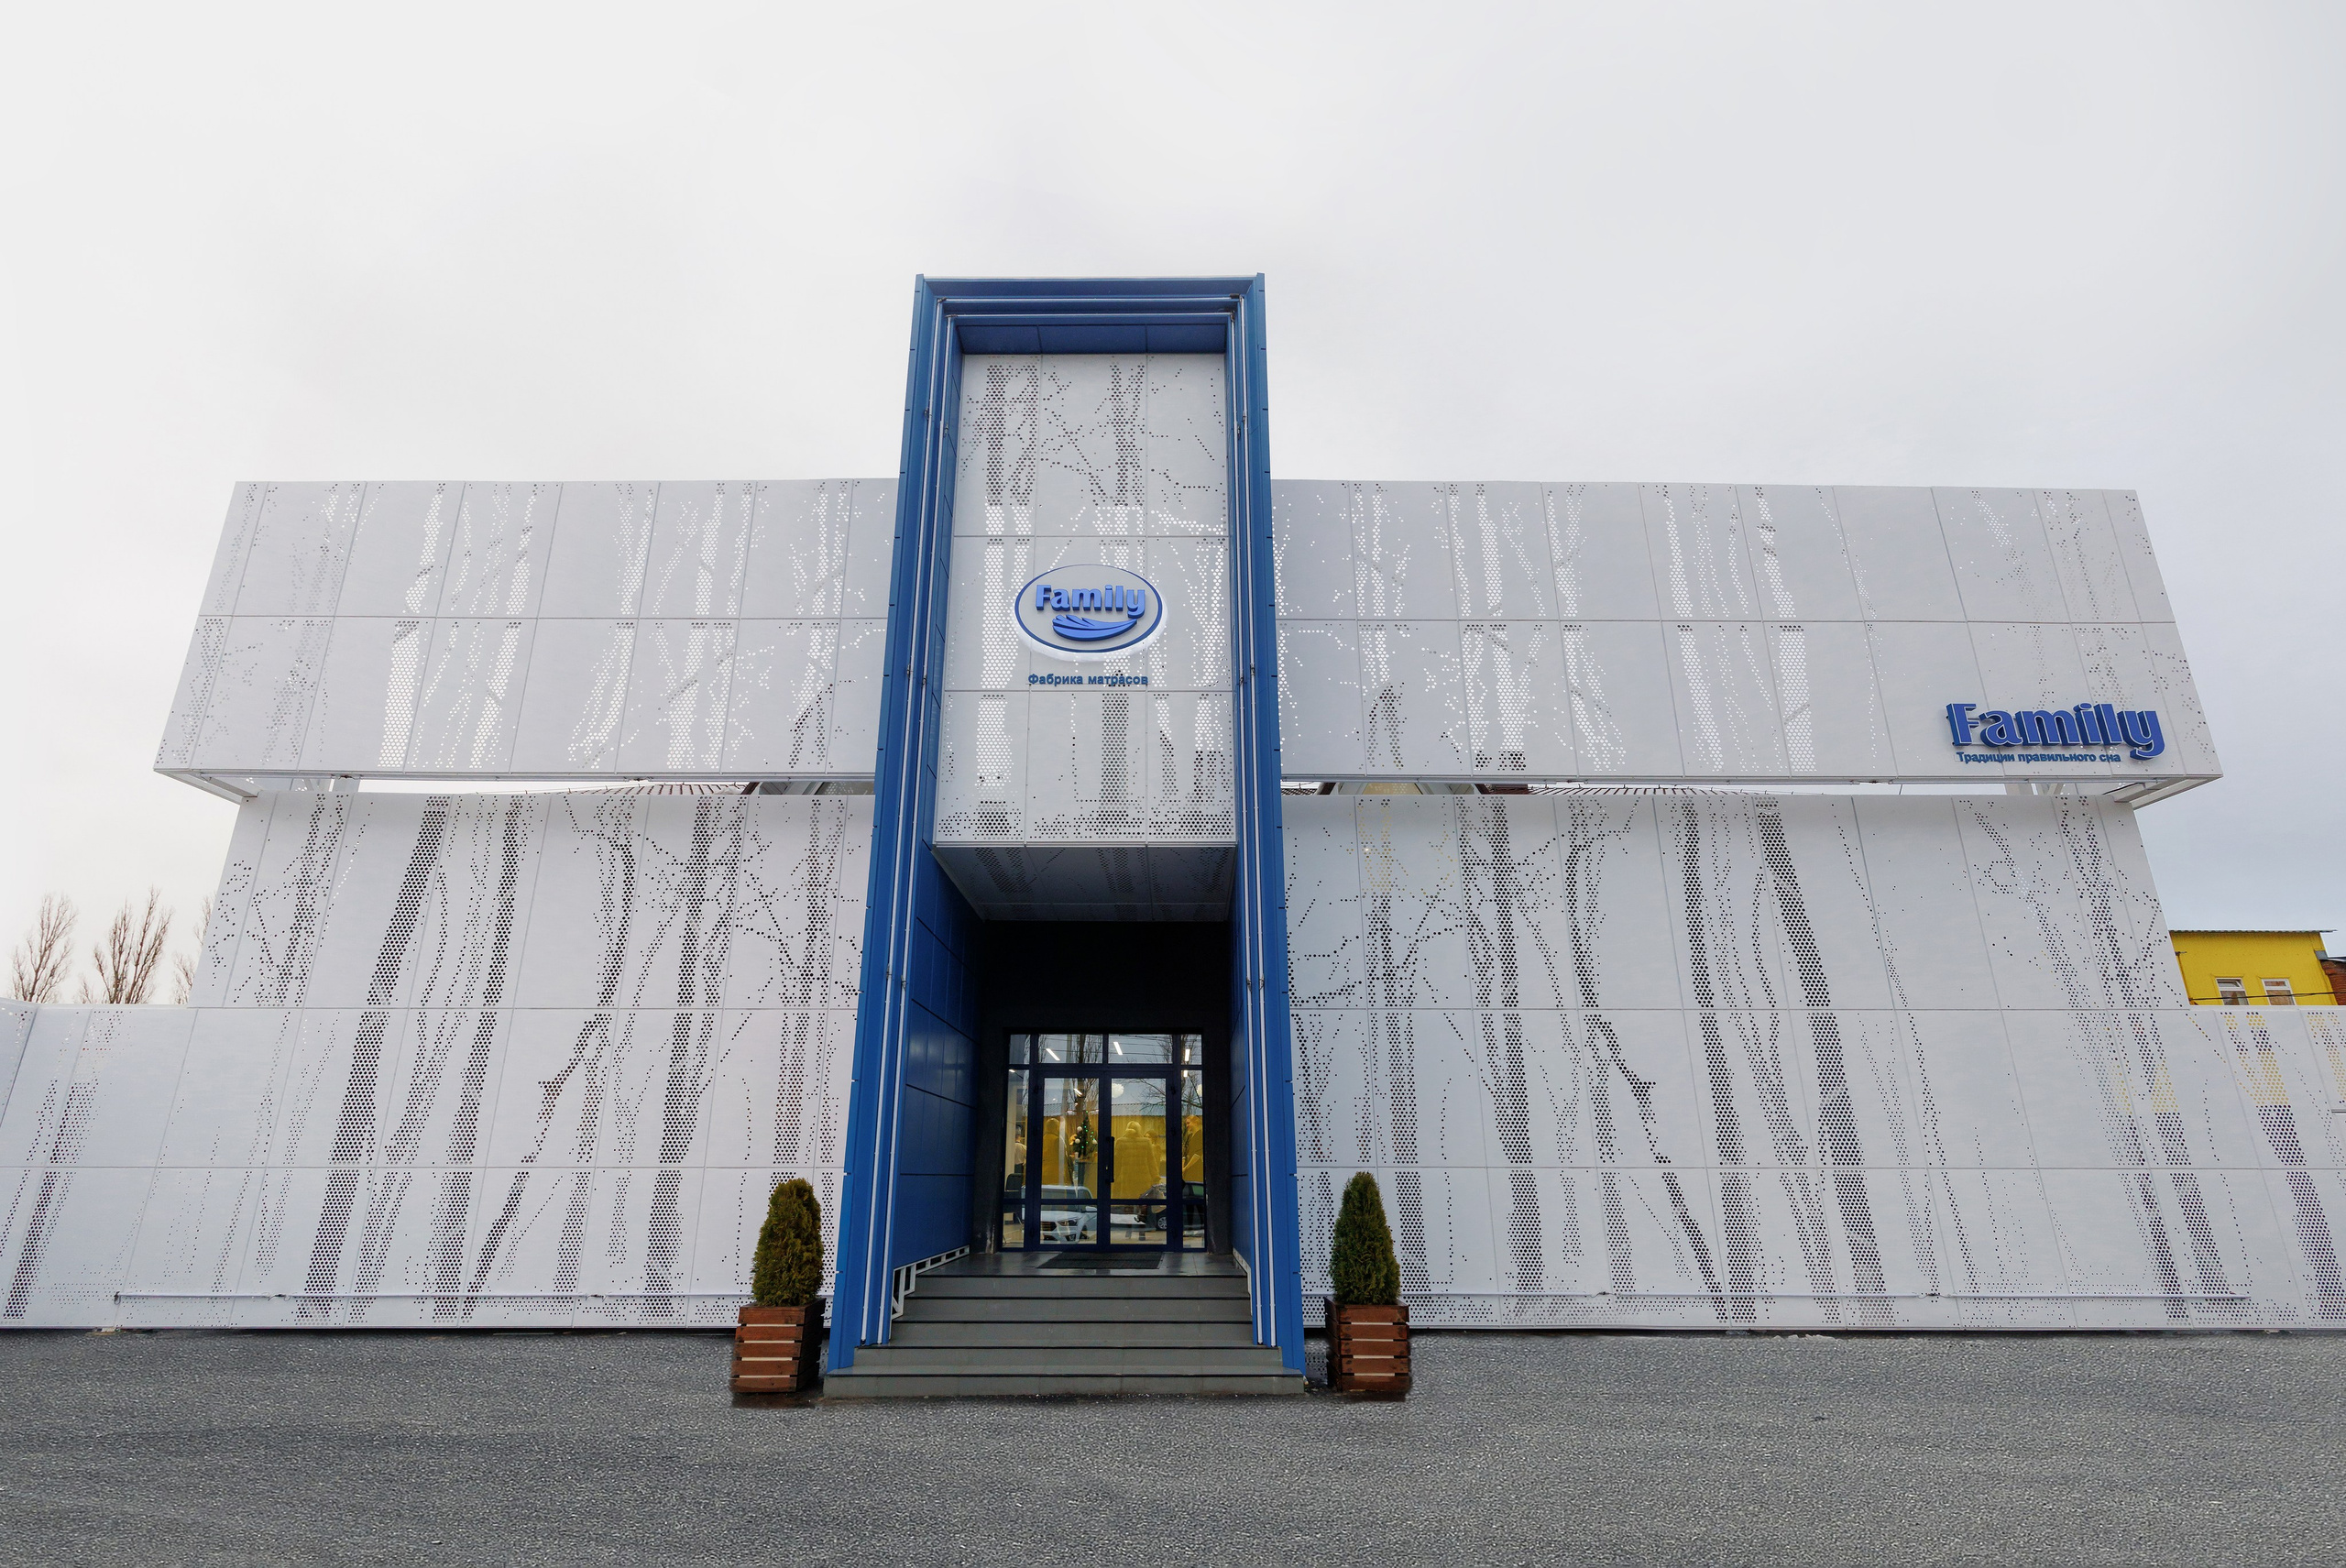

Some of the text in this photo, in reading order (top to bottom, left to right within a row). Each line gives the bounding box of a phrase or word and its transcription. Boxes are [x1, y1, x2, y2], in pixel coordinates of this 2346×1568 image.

[1036, 585, 1146, 619] Family
[1027, 674, 1148, 686] Фабрика матрасов
[1946, 703, 2165, 761] Family
[1956, 751, 2121, 764] Традиции правильного сна
